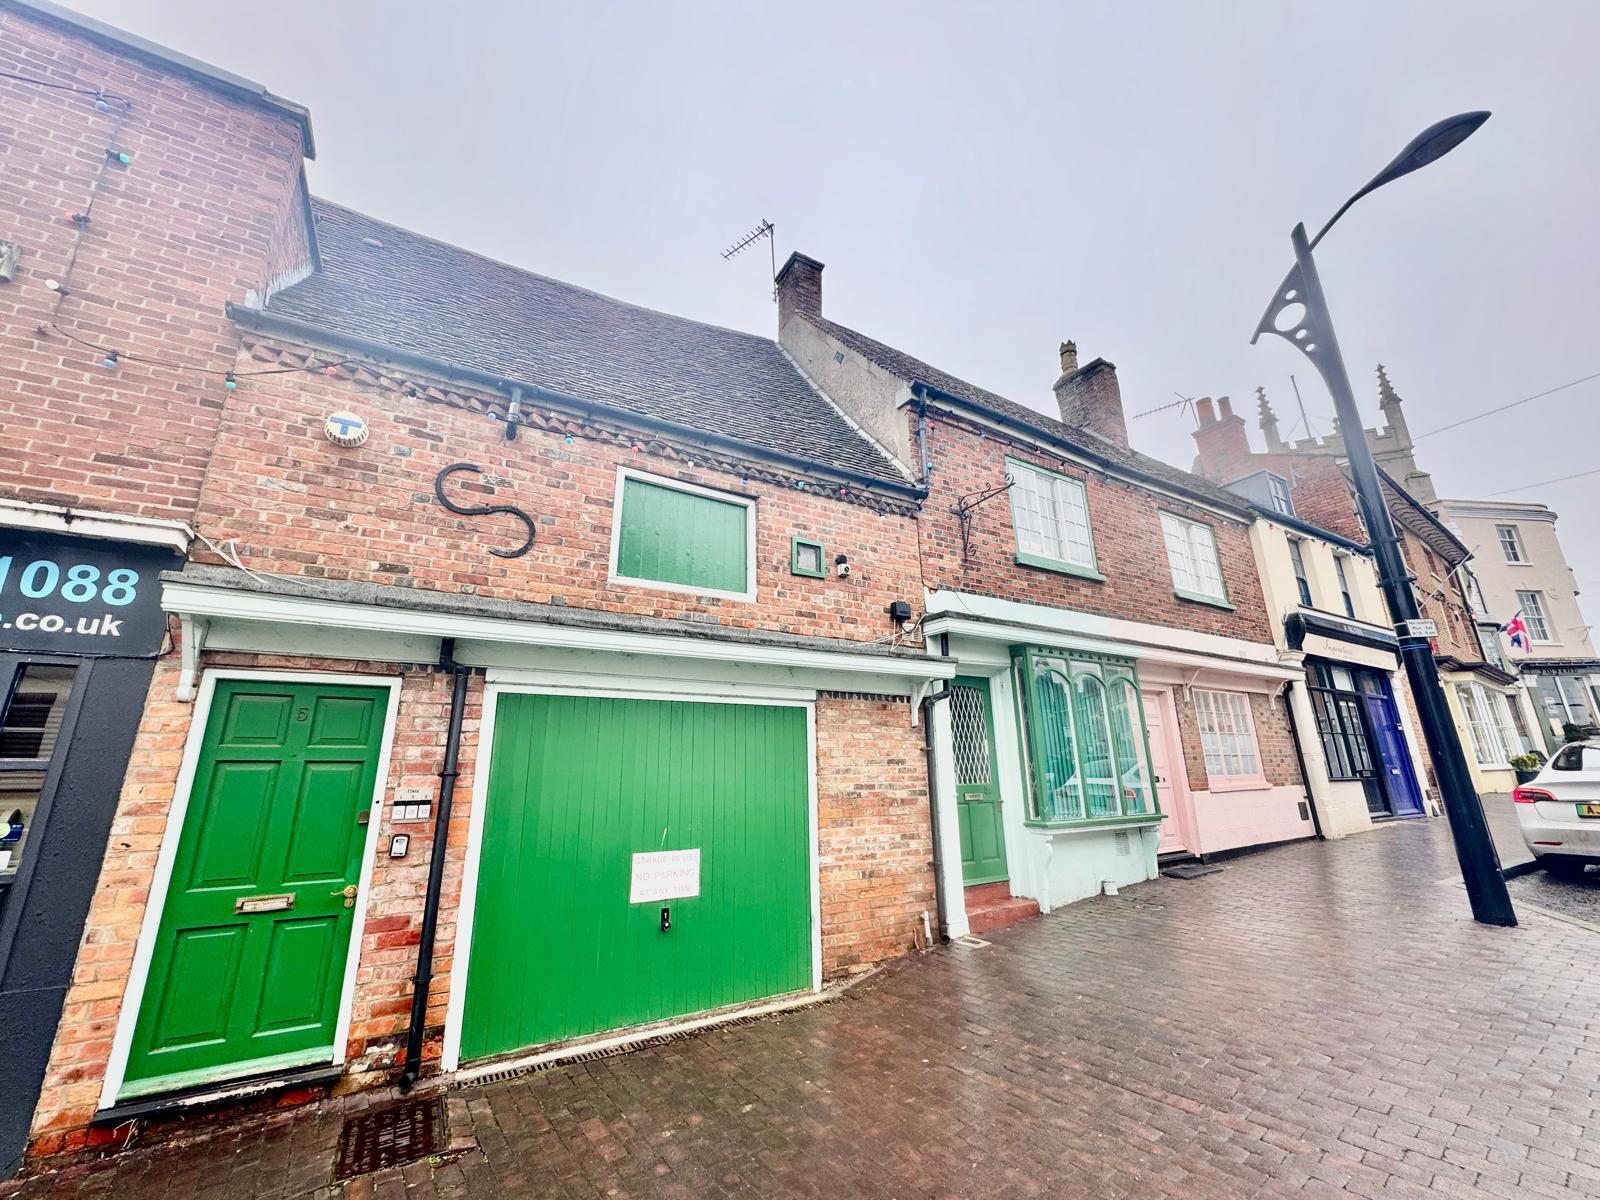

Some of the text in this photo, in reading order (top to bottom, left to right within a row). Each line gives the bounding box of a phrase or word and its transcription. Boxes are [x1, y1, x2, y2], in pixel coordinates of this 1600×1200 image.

[0, 612, 124, 637] .co.uk
[635, 868, 695, 881] NO PARKING
